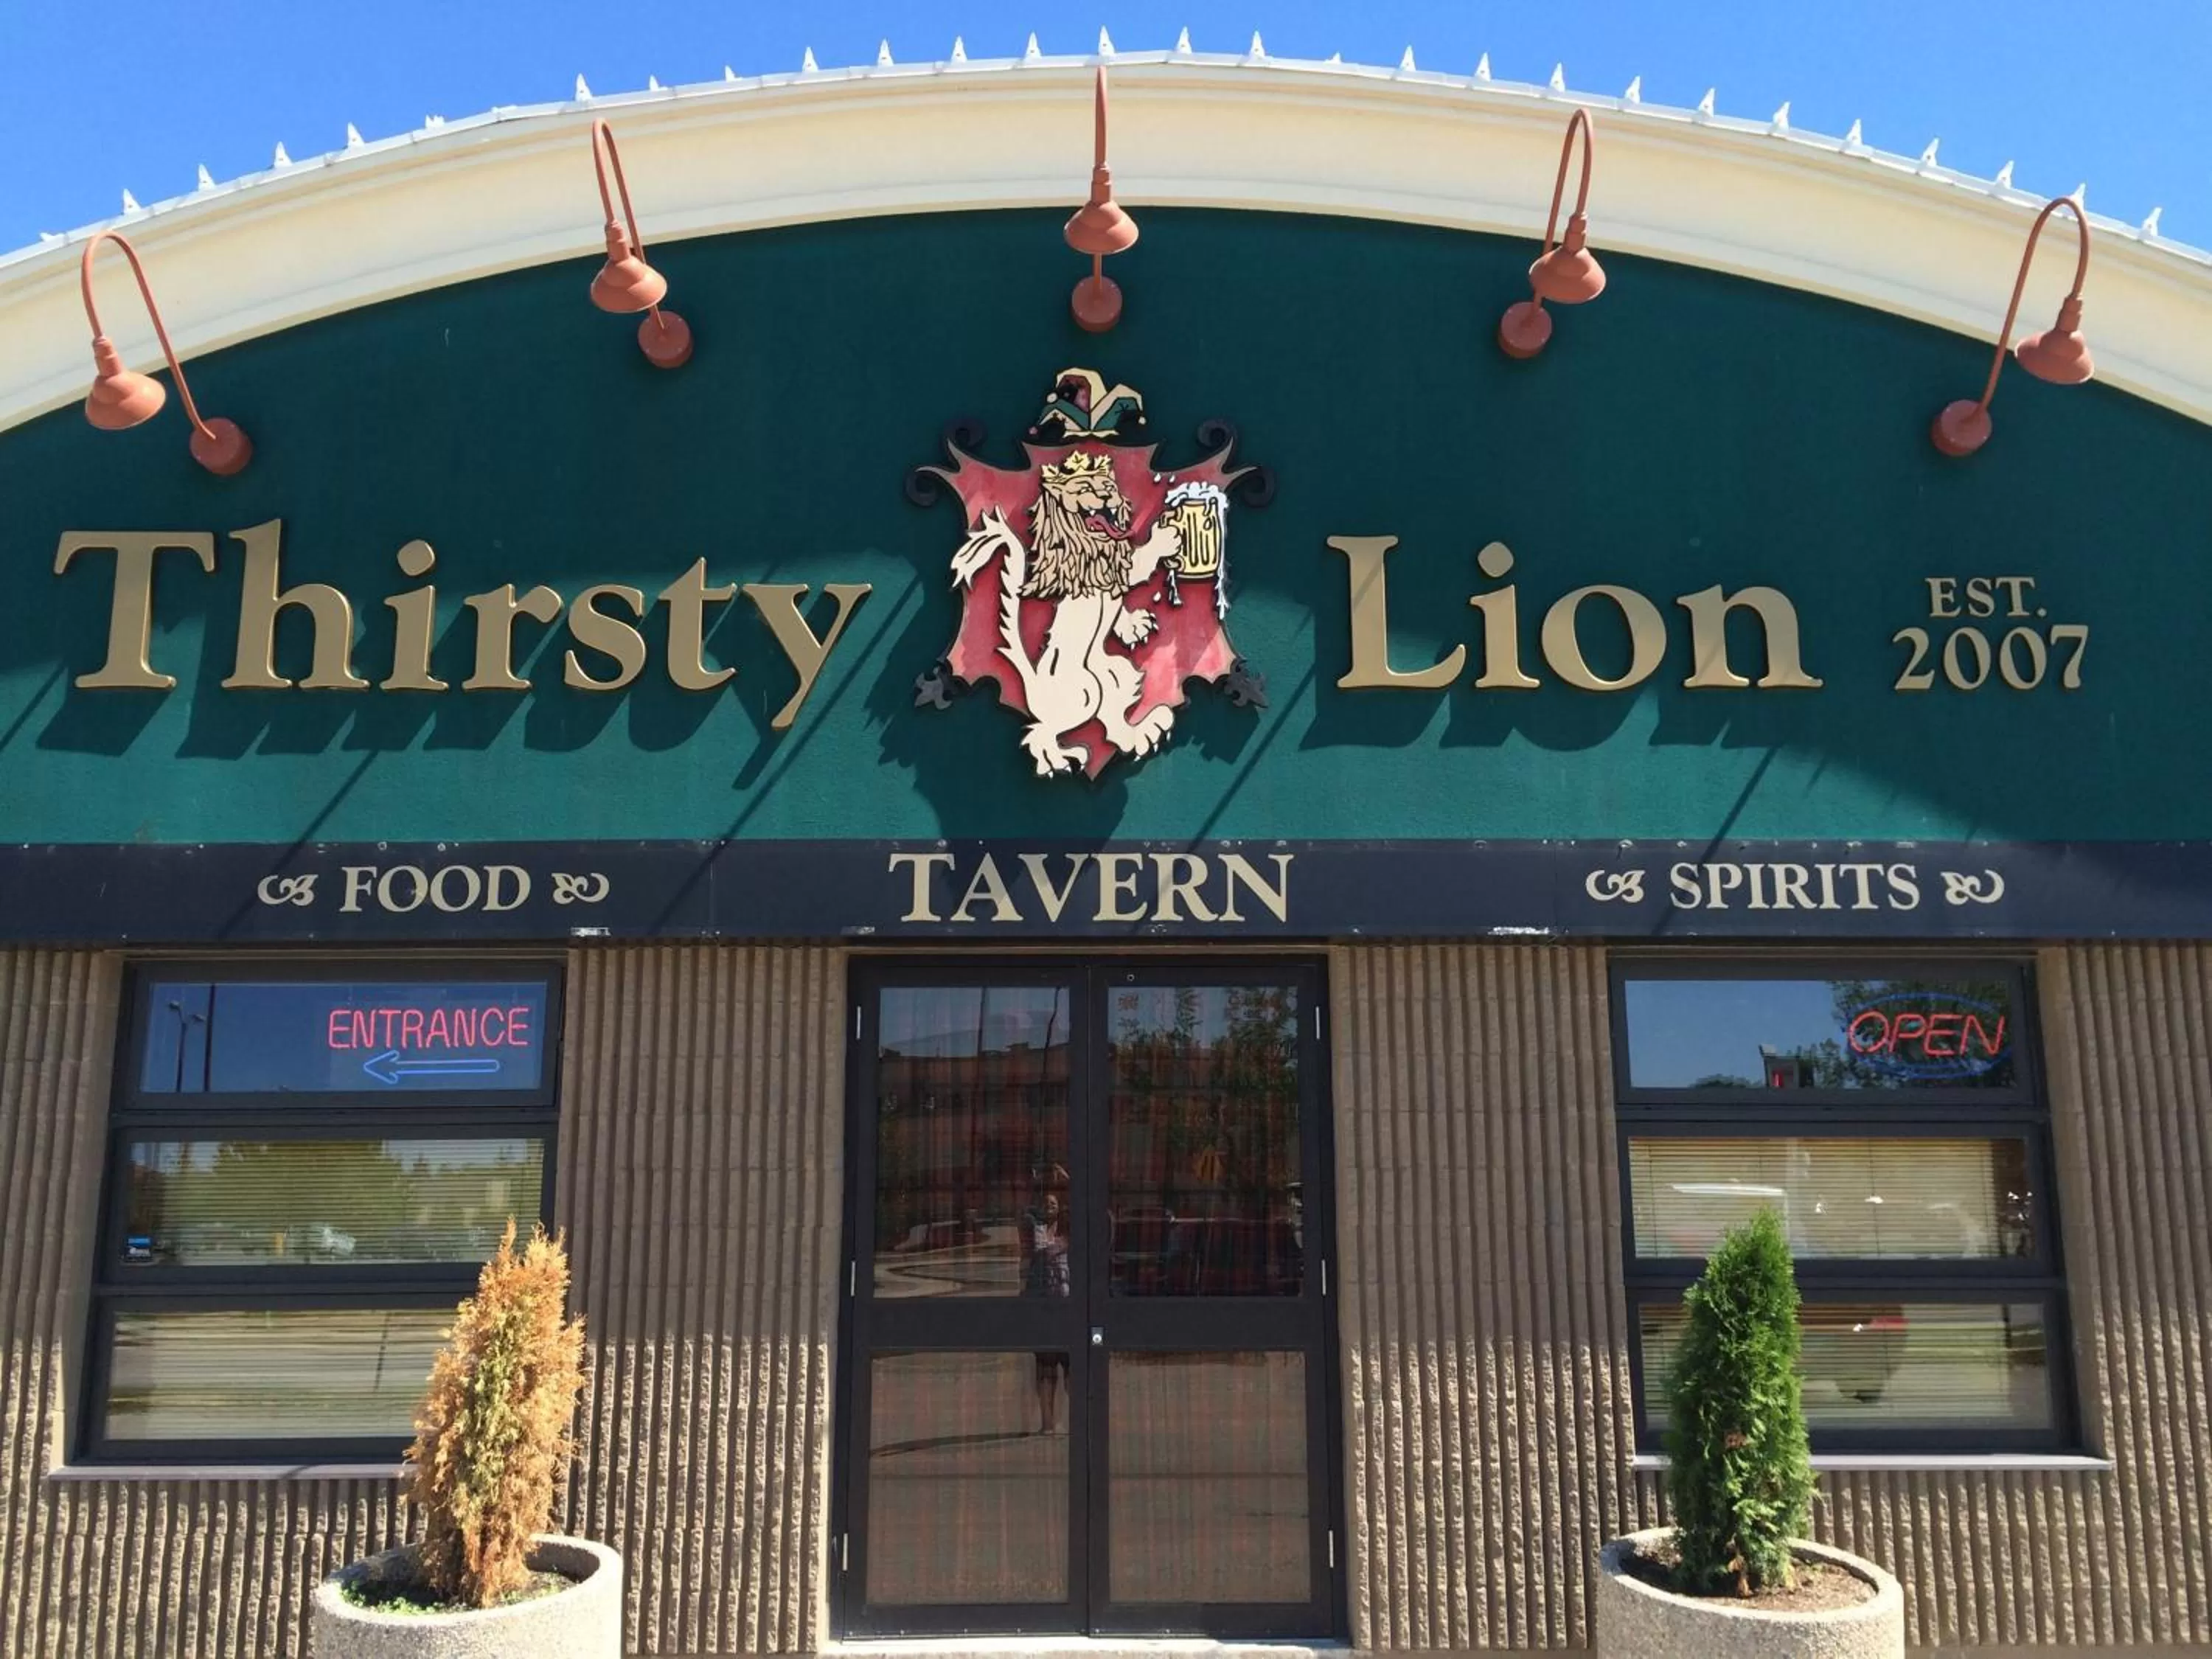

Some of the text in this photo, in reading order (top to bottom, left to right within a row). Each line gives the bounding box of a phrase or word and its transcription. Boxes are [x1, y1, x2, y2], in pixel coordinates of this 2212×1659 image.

[1924, 576, 2048, 619] EST.
[55, 518, 1823, 728] Thirsty Lion
[1892, 625, 2088, 689] 2007
[339, 866, 531, 913] FOOD
[889, 852, 1294, 923] TAVERN
[1669, 863, 1920, 910] SPIRITS
[328, 1007, 529, 1049] ENTRANCE
[1848, 1011, 2005, 1055] OPEN
